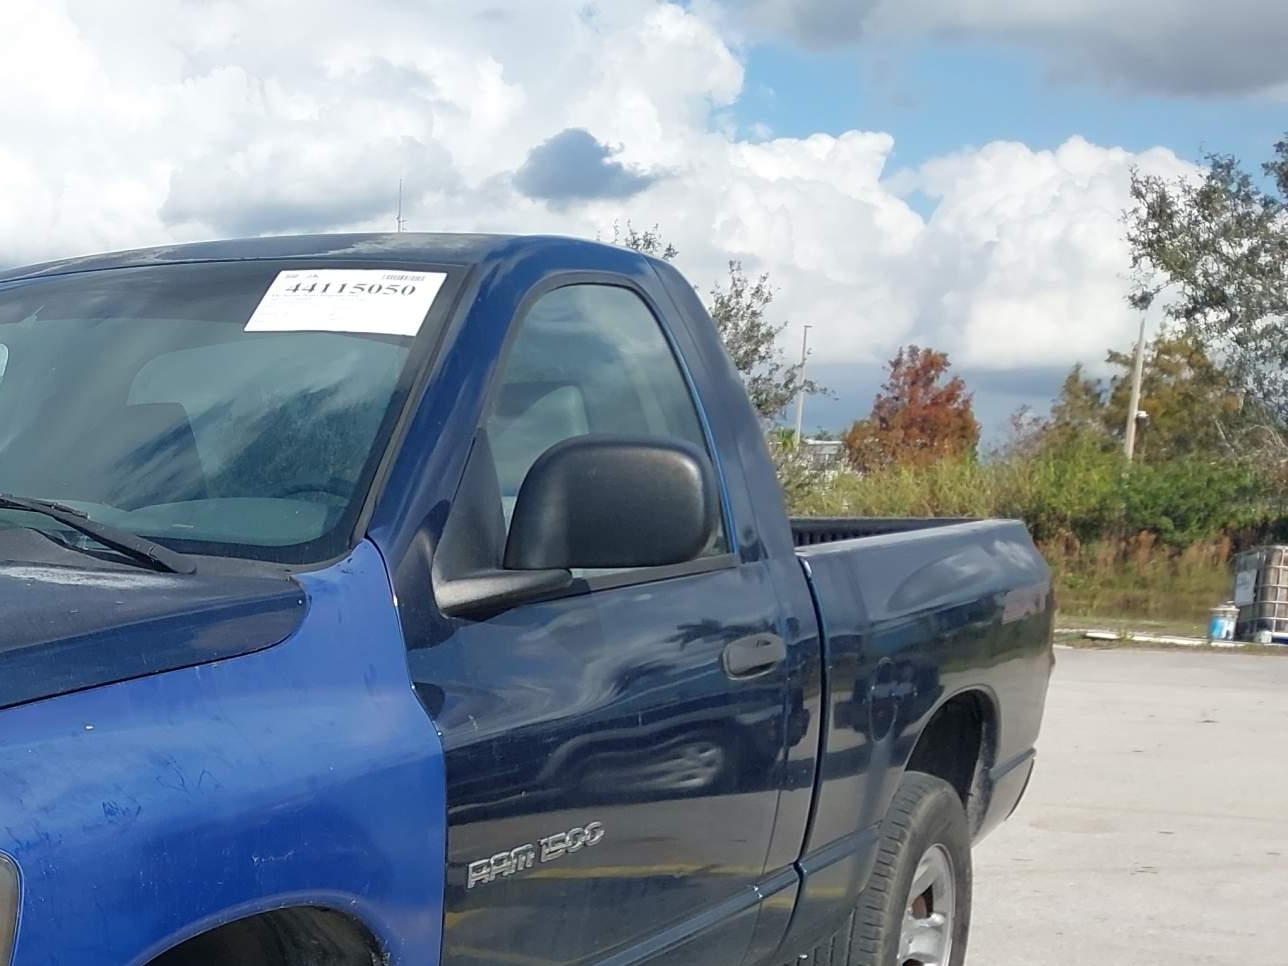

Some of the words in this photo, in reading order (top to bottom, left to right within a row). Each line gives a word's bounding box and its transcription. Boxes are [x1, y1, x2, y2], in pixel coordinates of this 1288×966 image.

[285, 282, 417, 296] 44115050
[467, 843, 536, 889] RAM
[538, 820, 605, 863] 1500
